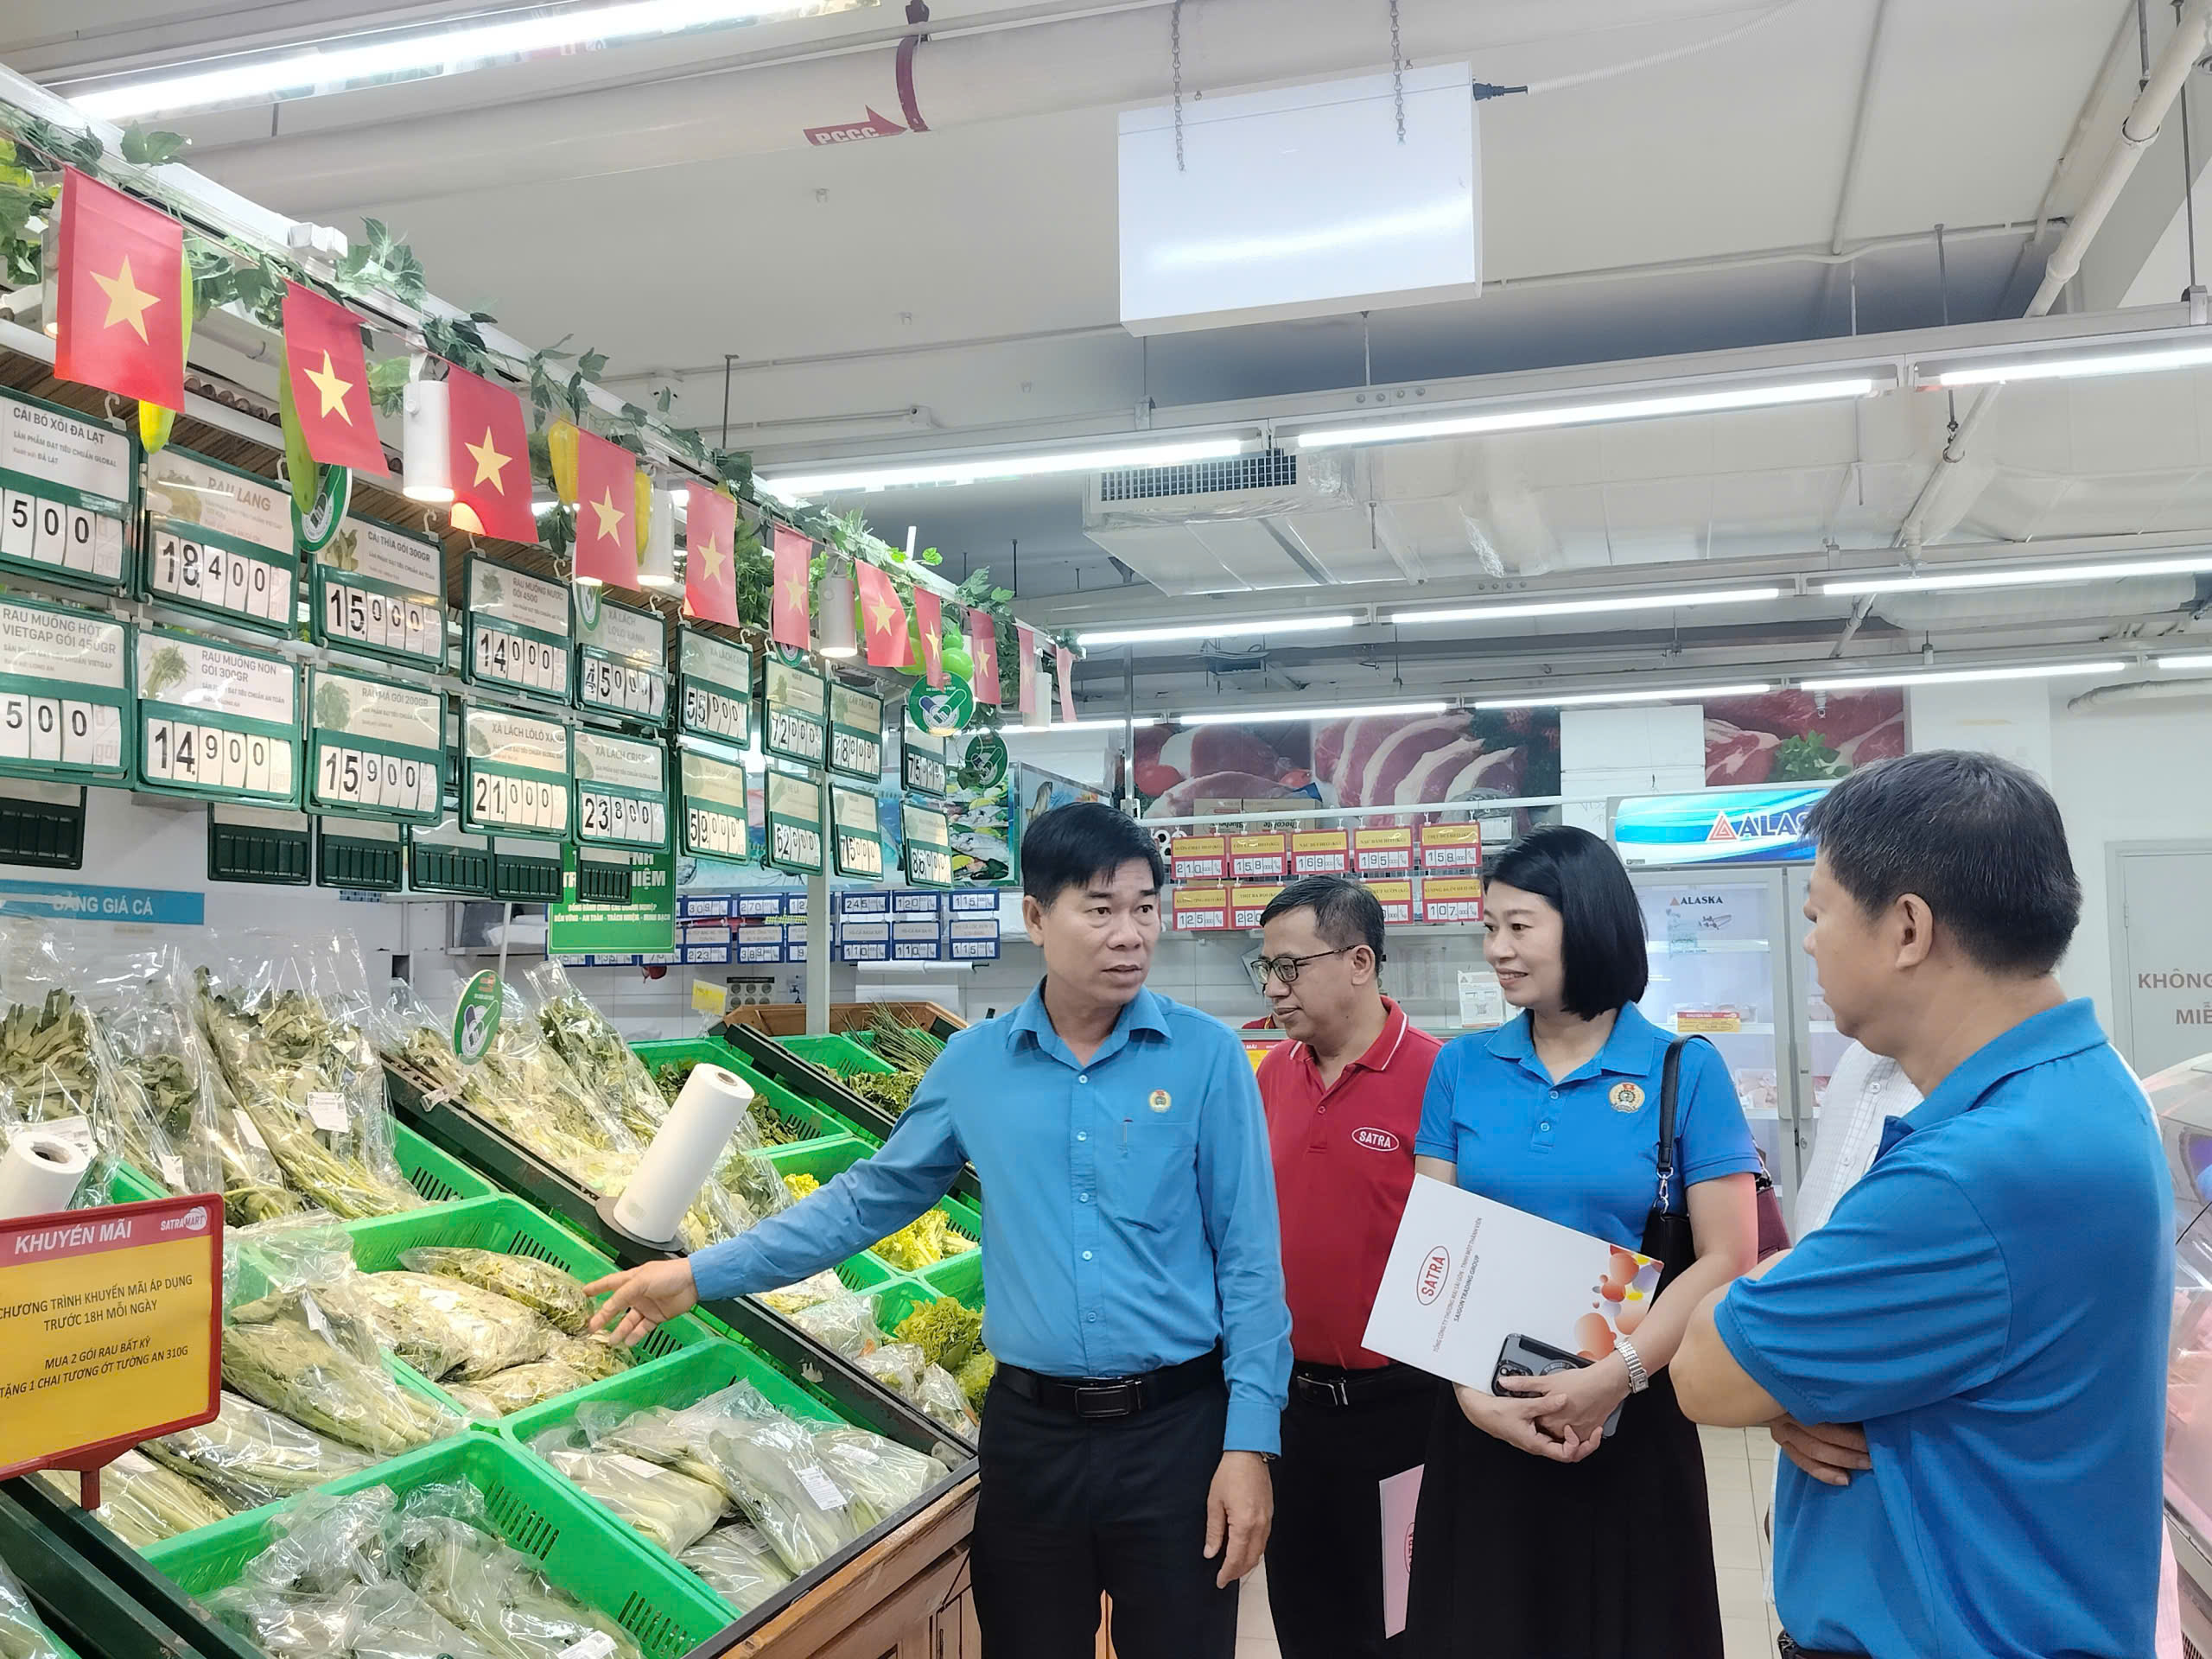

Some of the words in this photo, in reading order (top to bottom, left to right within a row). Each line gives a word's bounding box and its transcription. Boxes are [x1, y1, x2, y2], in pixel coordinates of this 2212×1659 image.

[815, 127, 879, 144] PCCC
[86, 430, 105, 445] LẠT
[237, 487, 271, 512] LANG
[3, 607, 29, 623] RAU
[31, 613, 76, 632] MUỐNG
[3, 623, 54, 643] VIETGAP
[55, 633, 76, 647] GÓI
[201, 650, 220, 664] RAU
[257, 665, 277, 676] NON
[155, 726, 264, 776] 14.900
[326, 752, 416, 795] 15.900
[103, 895, 129, 914] GIÁ
[1681, 895, 1724, 905] ALASKA
[1359, 1130, 1391, 1148] SATRA
[15, 1222, 98, 1255] KHUYẾN
[99, 1217, 131, 1243] MÃI
[1421, 1255, 1446, 1297] SATRA
[1454, 1300, 1465, 1322] SAIGON
[1461, 1274, 1473, 1300] TRADING
[1471, 1255, 1480, 1274] GROUP
[0, 1300, 48, 1320] CHƯƠNG
[50, 1293, 82, 1310] TRÌNH
[85, 1282, 125, 1305] KHUYẾN
[128, 1281, 148, 1297] MÃI
[149, 1277, 162, 1292] ÁP
[164, 1274, 193, 1292] DỤNG
[44, 1313, 82, 1332] TRƯỚC
[85, 1310, 104, 1324] 18H
[106, 1301, 128, 1319] MỖI
[130, 1299, 158, 1315] NGÀY
[44, 1356, 69, 1370] MUA
[71, 1353, 77, 1363] 2
[79, 1347, 97, 1362] GÓI
[99, 1344, 118, 1357] RAU
[120, 1337, 139, 1353] BẤT
[0, 1382, 27, 1399] TẶNG
[29, 1381, 35, 1391] 1
[37, 1375, 60, 1389] CHAI
[63, 1365, 99, 1383] TƯƠNG
[100, 1359, 115, 1374] ỚT
[117, 1353, 149, 1370] TƯỜNG
[151, 1351, 165, 1362] AN
[166, 1345, 189, 1359] 310G
